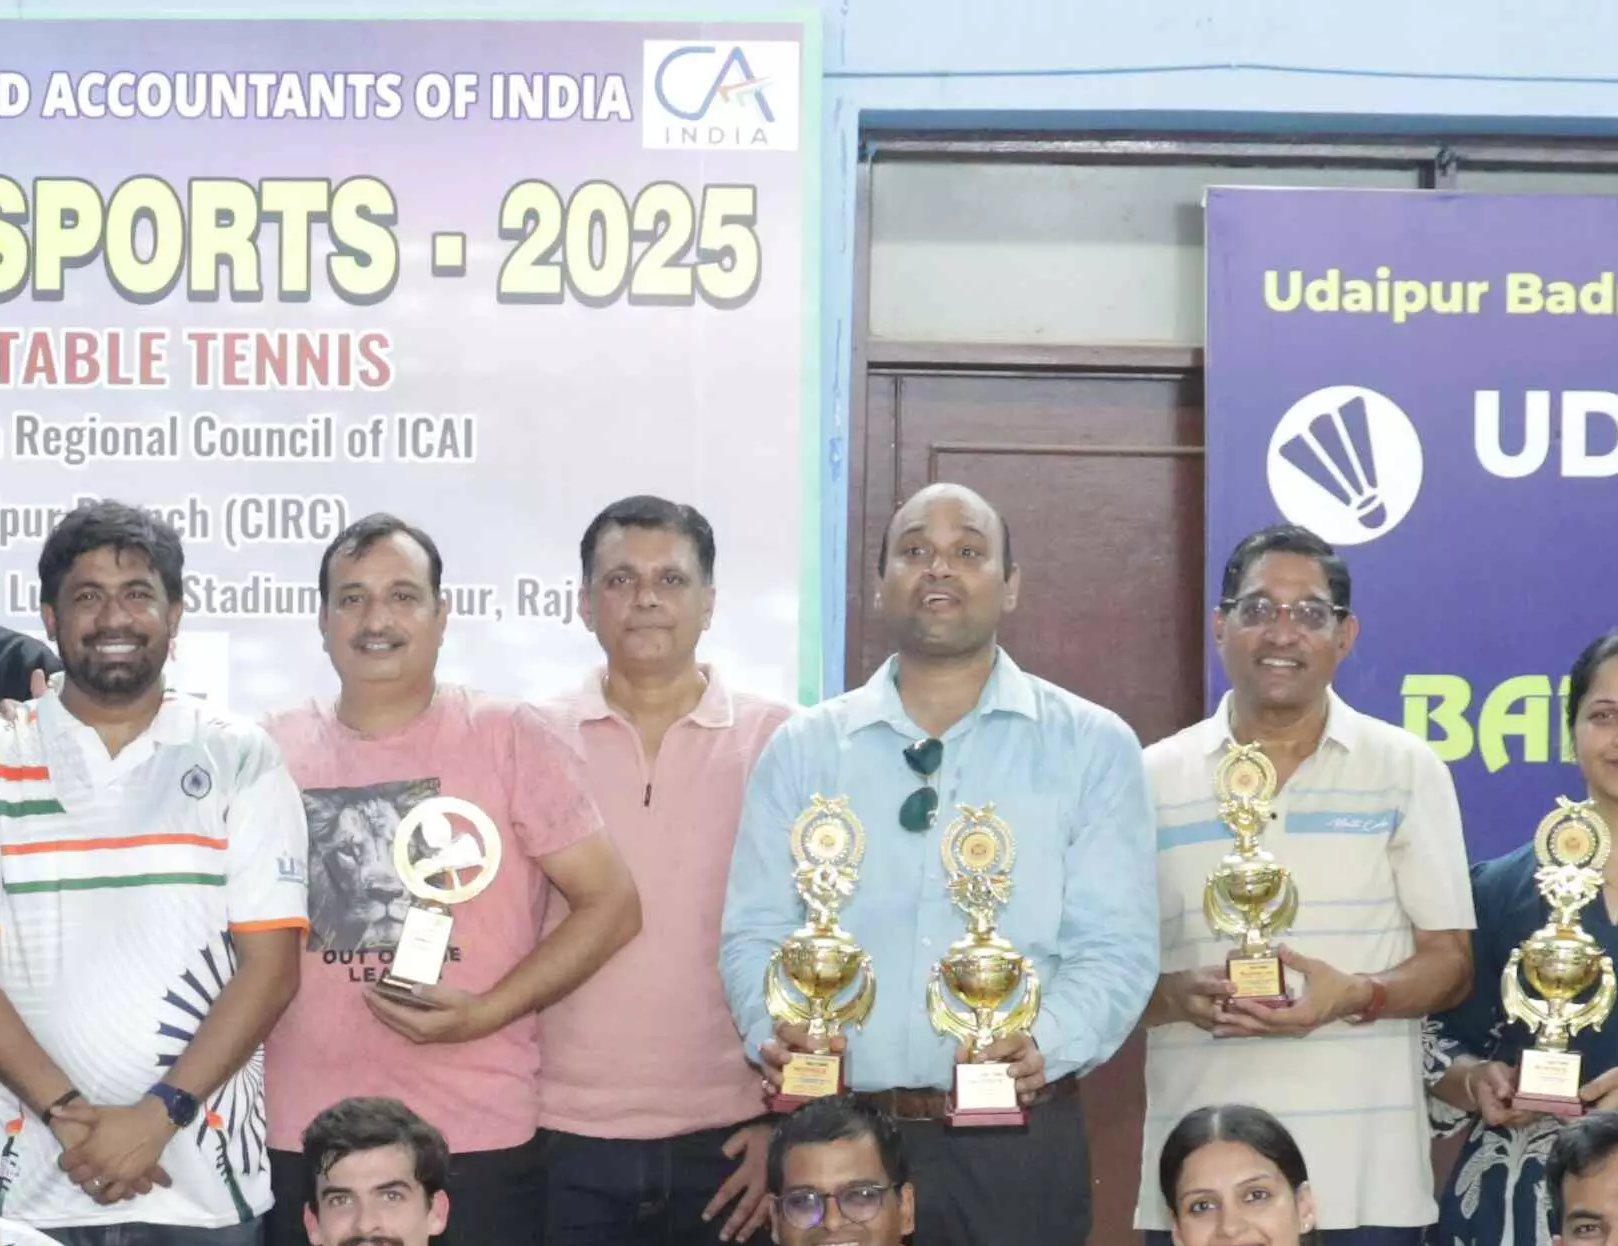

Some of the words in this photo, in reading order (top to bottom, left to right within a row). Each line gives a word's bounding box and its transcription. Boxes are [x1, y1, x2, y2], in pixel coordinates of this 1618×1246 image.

[41, 72, 404, 121] ACCOUNTANTS
[414, 73, 478, 121] OF
[489, 73, 634, 122] INDIA
[665, 126, 768, 145] INDIA
[431, 231, 466, 278] -
[497, 179, 762, 309] 2025
[1264, 267, 1489, 323] Udaipur
[189, 331, 392, 387] TENNIS
[16, 415, 178, 464] Regional
[193, 415, 333, 459] Council
[347, 416, 382, 459] of
[397, 417, 475, 460] ICAI
[225, 497, 348, 548] (CIRC)
[183, 574, 320, 616] Stadium
[322, 948, 366, 965] OUT
[348, 967, 389, 983] LEA
